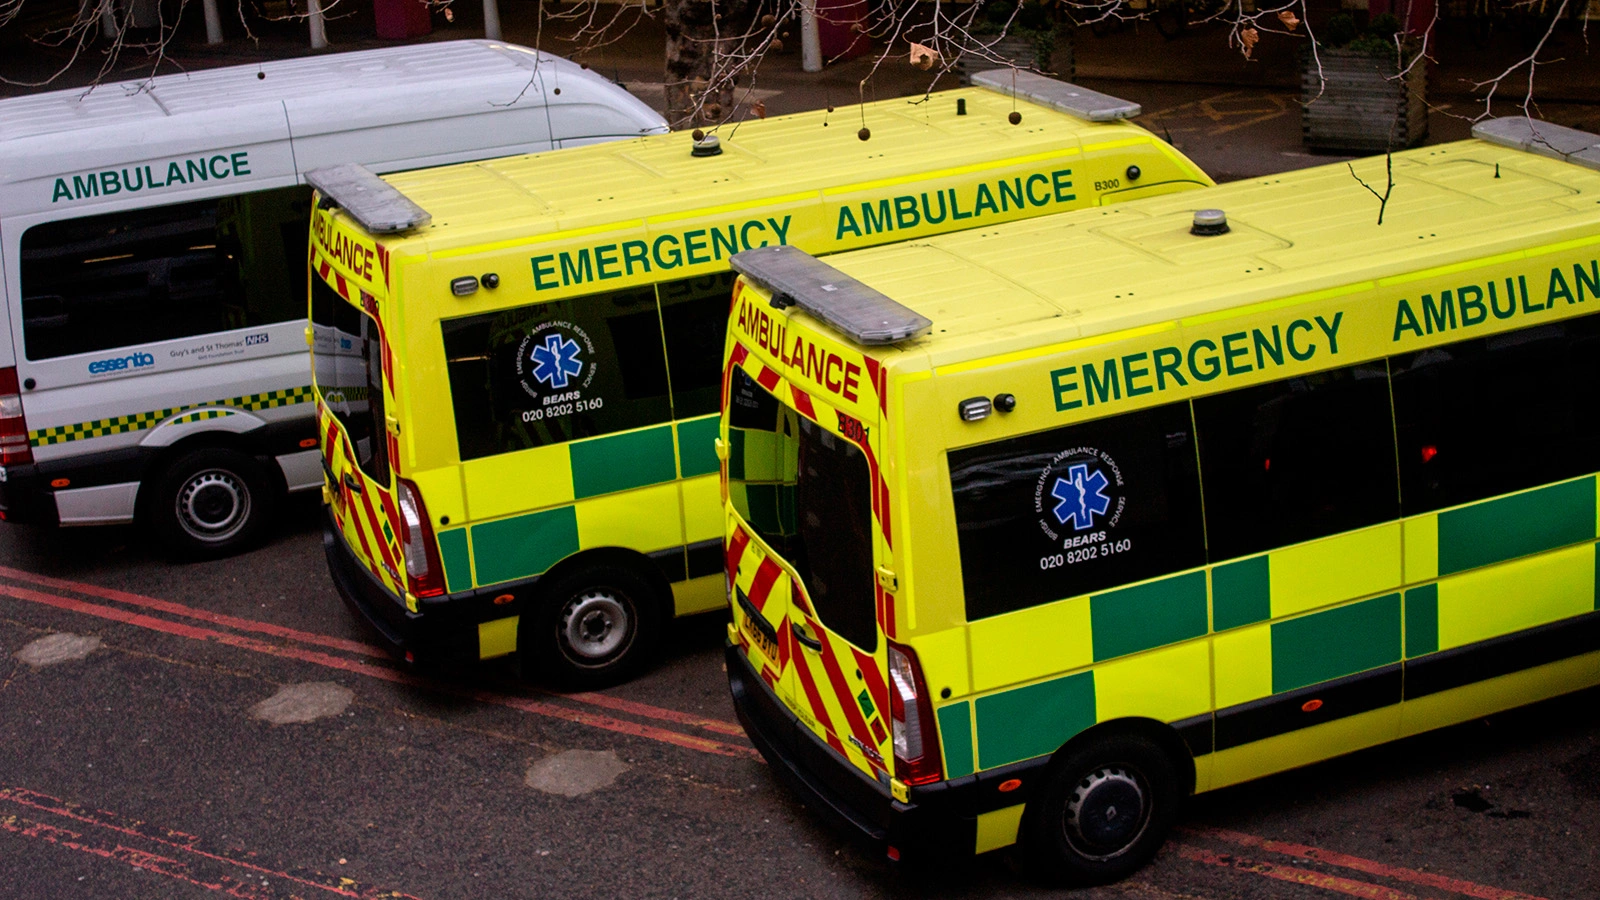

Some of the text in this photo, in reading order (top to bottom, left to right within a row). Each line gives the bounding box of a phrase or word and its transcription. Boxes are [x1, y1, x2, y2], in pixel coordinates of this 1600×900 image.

[52, 152, 251, 202] AMBULANCE
[1094, 178, 1120, 191] B300
[531, 169, 1076, 291] EMERGENCY AMBULANCE
[245, 333, 269, 346] NHS
[531, 320, 572, 335] AMBULANCE
[573, 325, 595, 355] RESPONSE
[88, 352, 155, 374] essentia
[169, 349, 189, 359] Guy's
[190, 345, 205, 354] and
[206, 343, 213, 352] St
[515, 334, 531, 375] EMERGENCY
[737, 296, 861, 404] AMBULANCE
[1050, 311, 1344, 413] EMERGENCY
[582, 362, 597, 388] SERVICE
[522, 397, 603, 422] 020 8202 5160
[542, 390, 581, 406] BEARS
[838, 412, 870, 445] B301
[1034, 446, 1126, 541] BRITISH EMERGENCY AMBULANCE RESPONSE SERVICE
[1040, 538, 1131, 570] 020 8202 5160
[1063, 531, 1107, 550] BEARS
